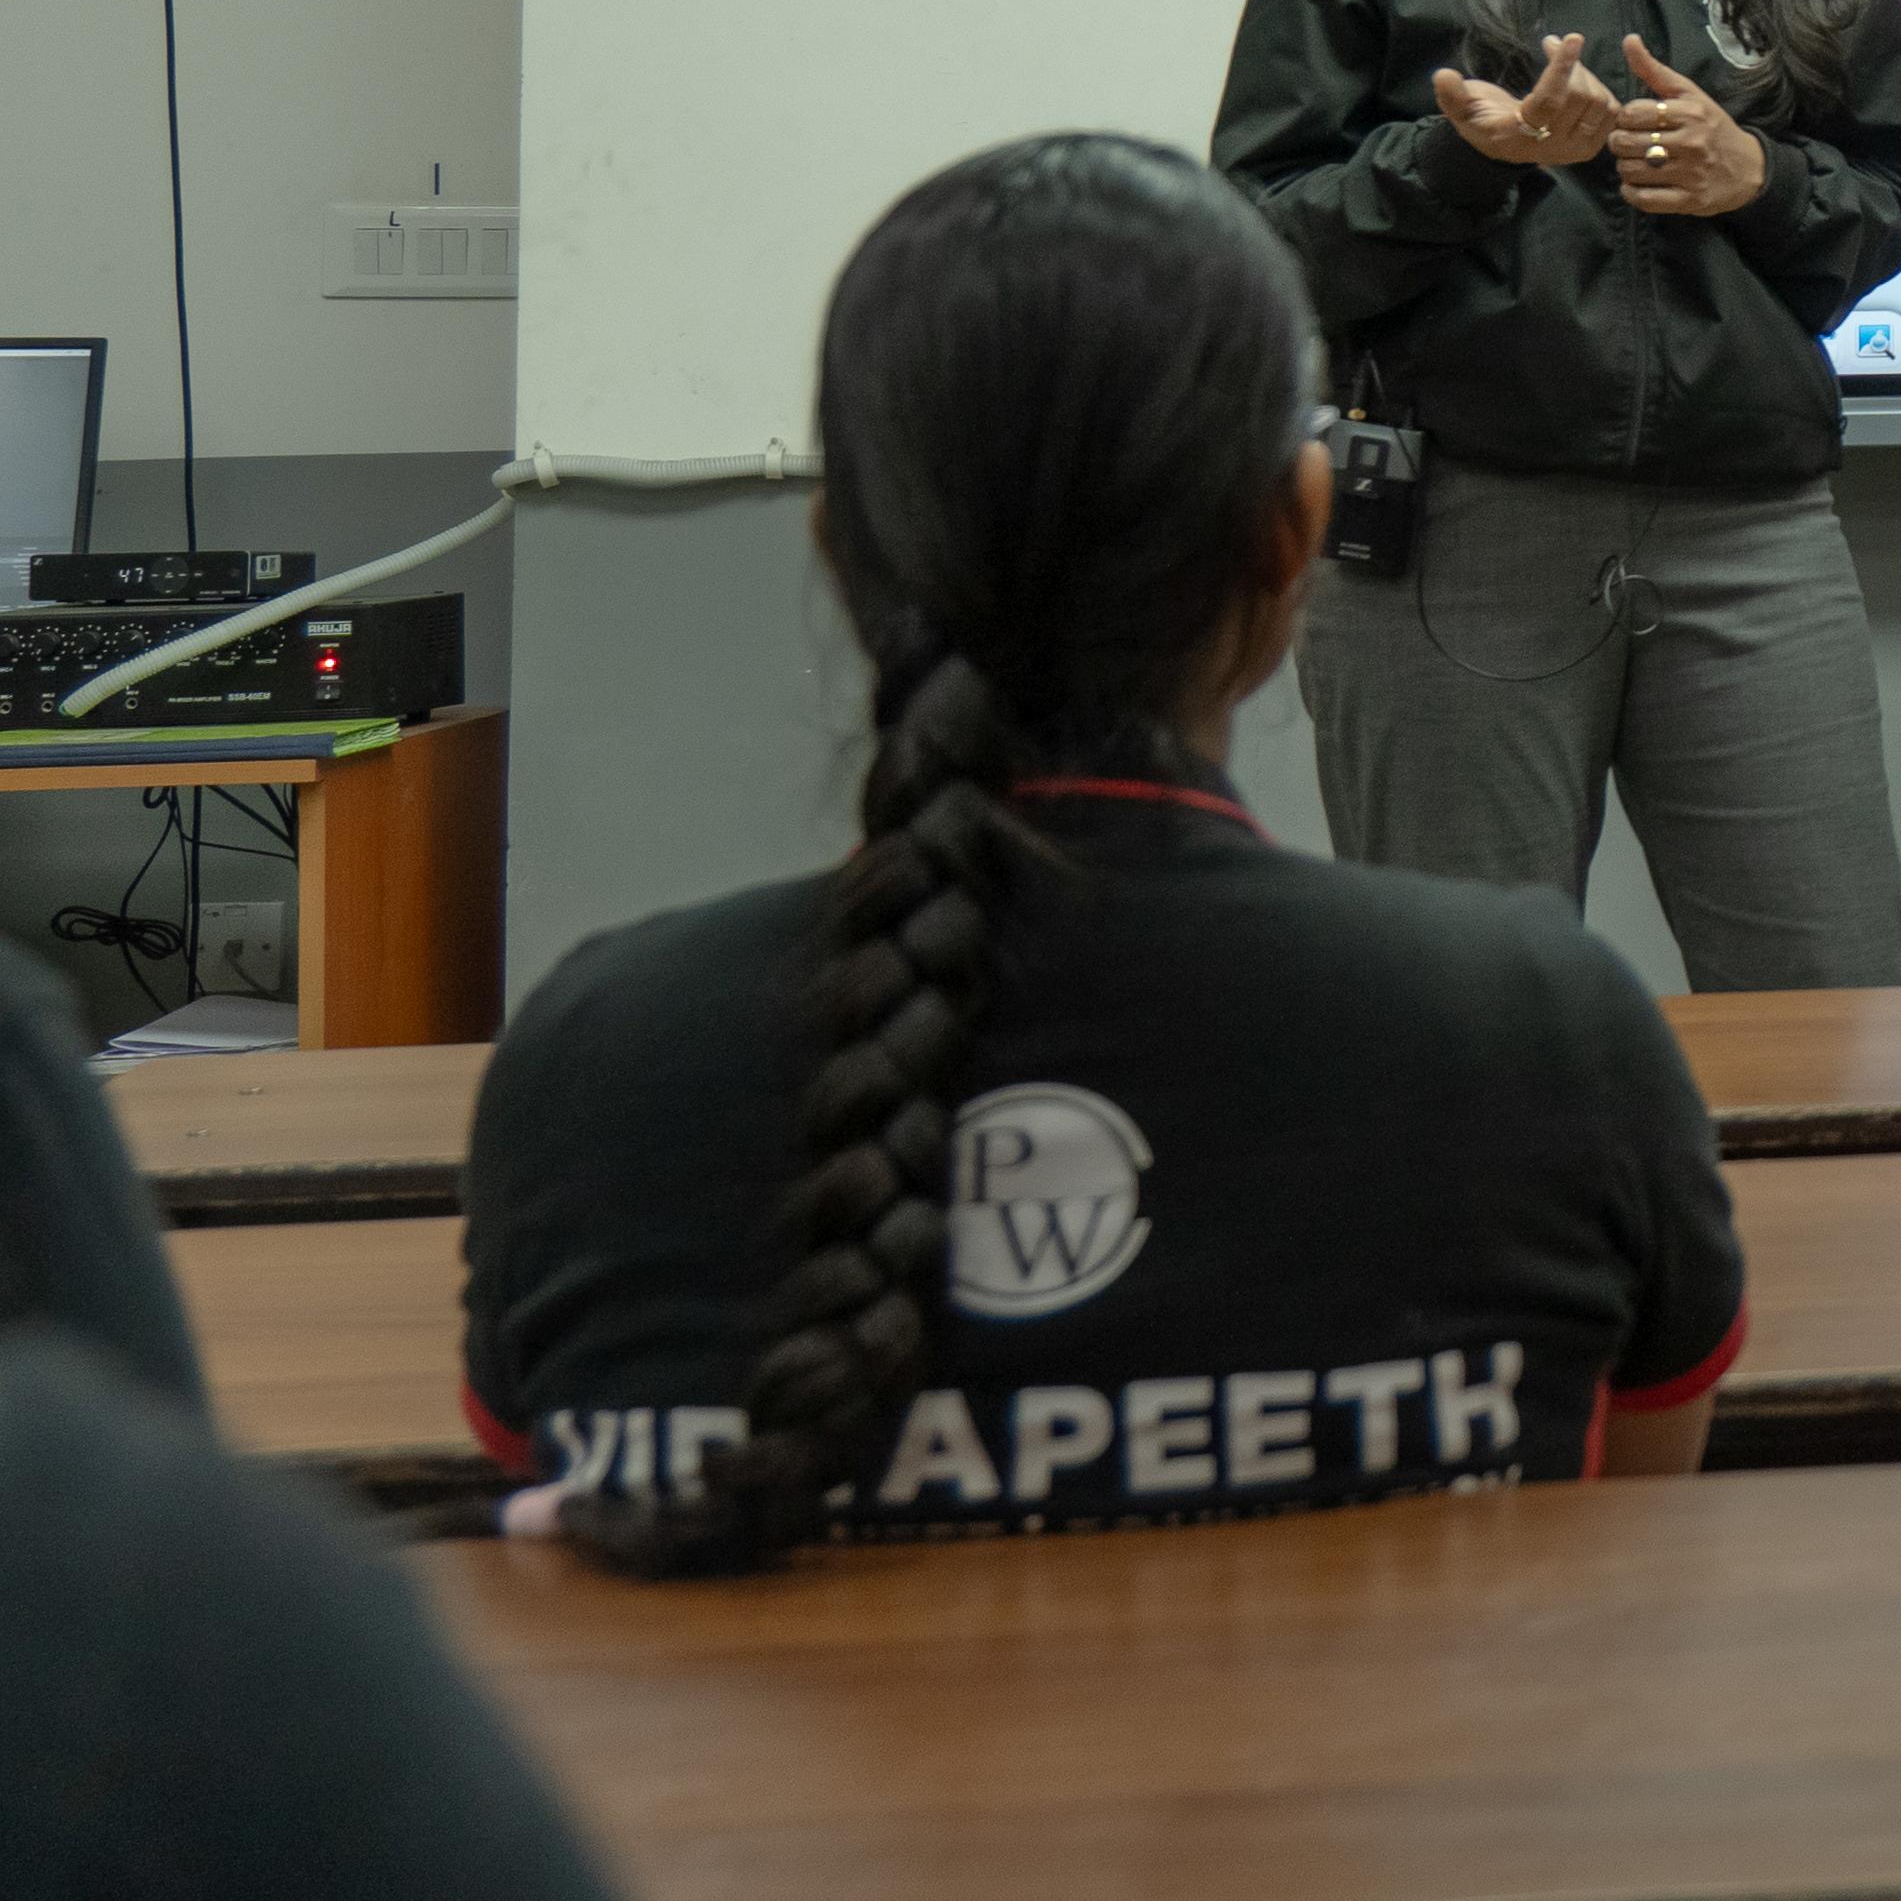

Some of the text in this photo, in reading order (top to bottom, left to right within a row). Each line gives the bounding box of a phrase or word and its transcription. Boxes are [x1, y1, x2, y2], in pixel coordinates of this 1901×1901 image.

[117, 566, 145, 583] 47
[308, 622, 352, 635] AHUJA
[969, 1128, 1116, 1281] PW
[548, 1342, 1524, 1502] VIAPEETH
